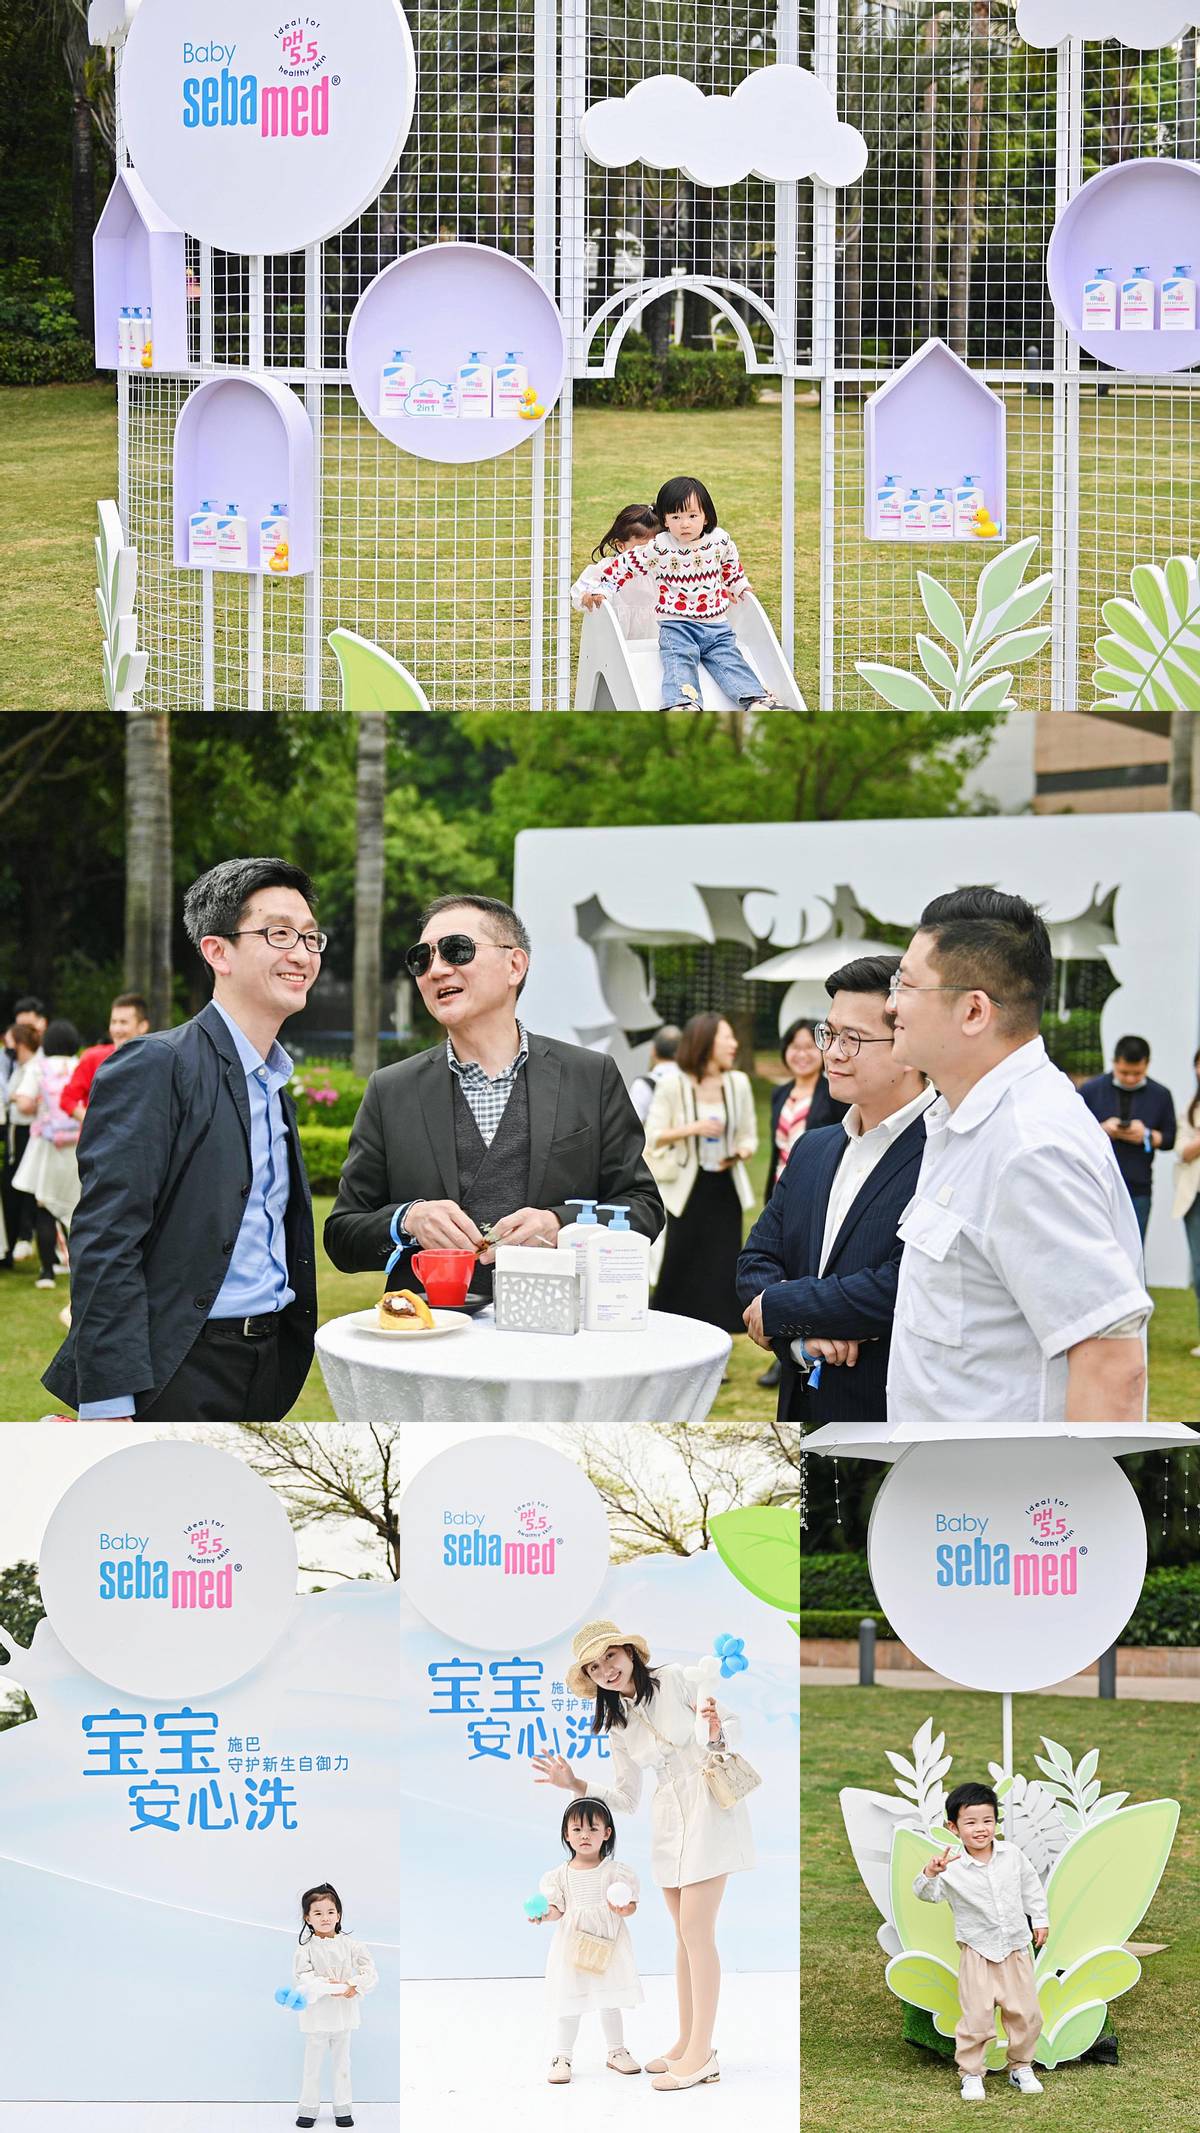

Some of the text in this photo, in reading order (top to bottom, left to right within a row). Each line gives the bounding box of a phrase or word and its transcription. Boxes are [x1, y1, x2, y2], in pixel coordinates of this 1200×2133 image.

[274, 17, 321, 39] Ideal for
[282, 30, 303, 52] pH
[183, 41, 236, 66] Baby
[290, 42, 318, 66] 5.5
[278, 55, 327, 77] healthy skin
[520, 1509, 536, 1521] pH
[1025, 1498, 1069, 1515] Ideal for
[444, 1511, 485, 1528] Baby
[526, 1517, 547, 1531] 5.5
[936, 1514, 989, 1535] Baby
[1033, 1508, 1053, 1526] pH
[184, 1520, 225, 1534] Ideal for
[191, 1528, 209, 1544] pH
[1040, 1519, 1067, 1538] 5.5
[100, 1533, 149, 1553] Baby
[198, 1538, 223, 1556] 5.5
[1029, 1529, 1075, 1547] healthy skin
[188, 1548, 230, 1564] healthy skin
[428, 1656, 545, 1713] 宝宝
[82, 1706, 220, 1776] 宝宝
[227, 1736, 261, 1753] 施巴
[468, 1715, 610, 1760] 安心洗
[227, 1755, 349, 1773] 守护新生自御力
[128, 1776, 298, 1832] 安心洗
